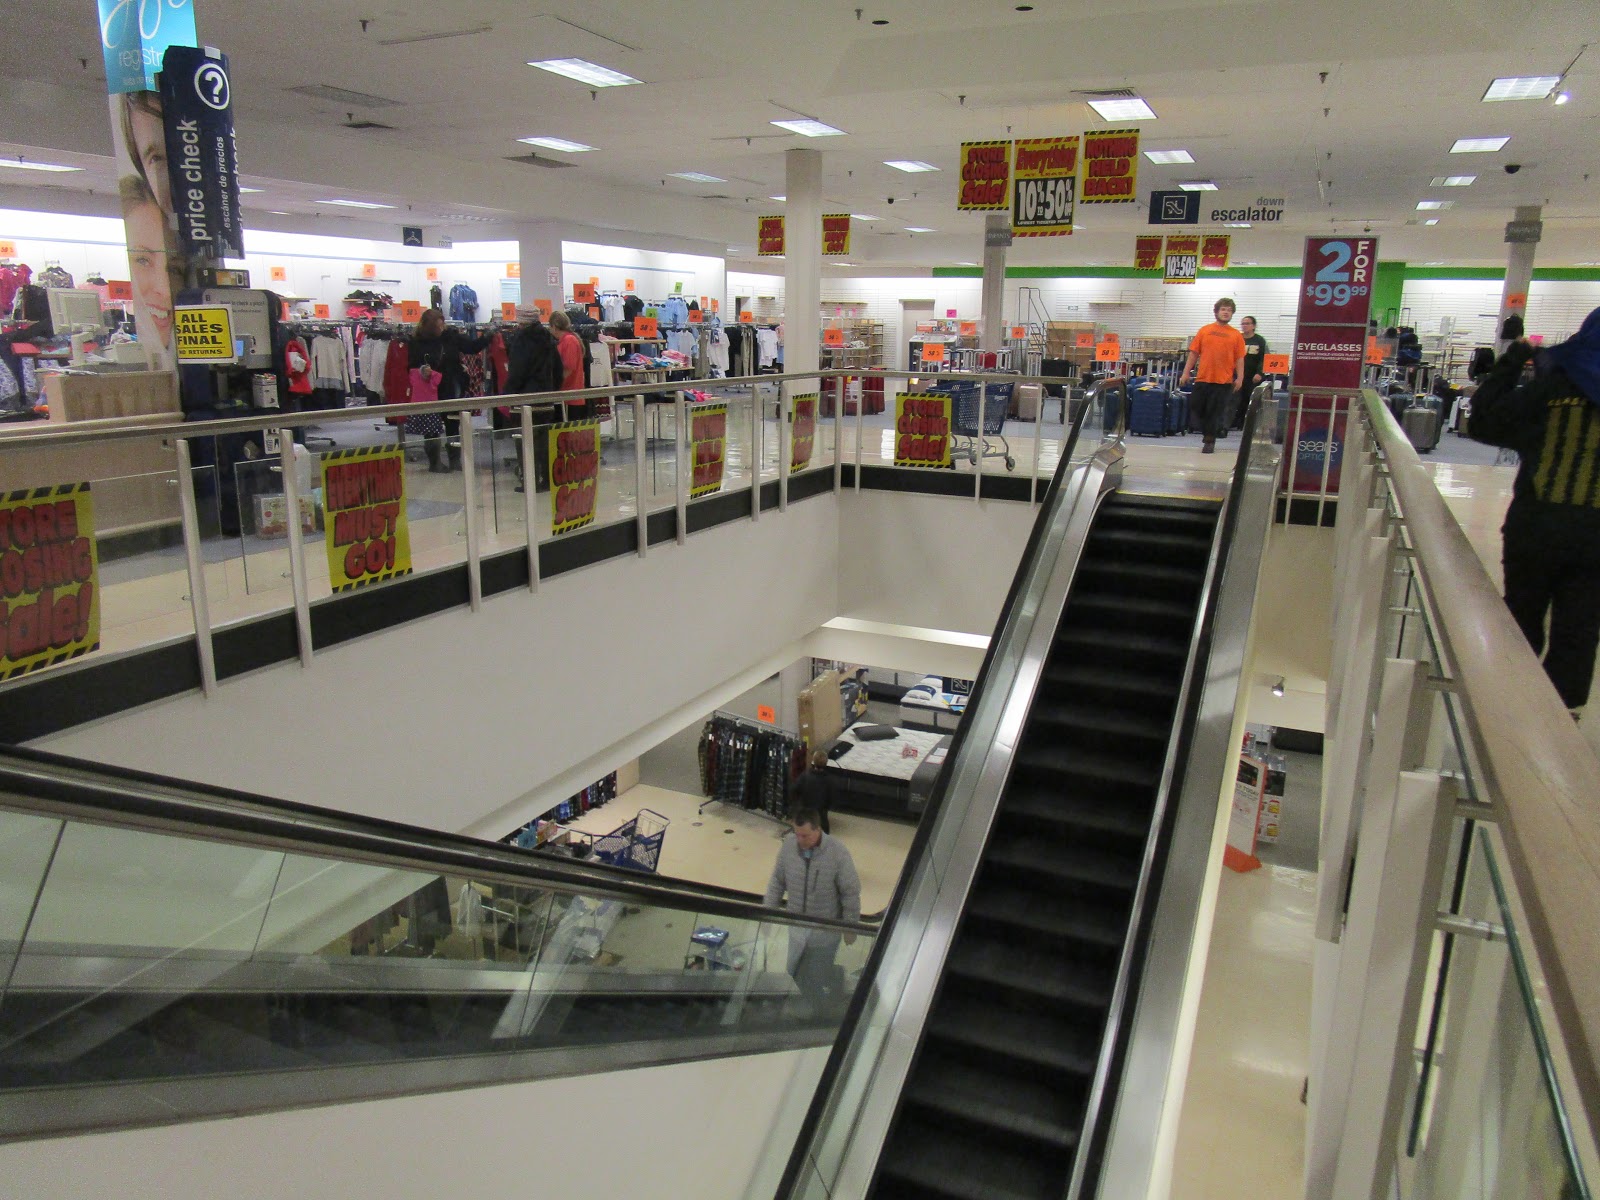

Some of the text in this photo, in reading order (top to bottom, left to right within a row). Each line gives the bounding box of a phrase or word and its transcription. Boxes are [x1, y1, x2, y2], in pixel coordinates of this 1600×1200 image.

[215, 136, 228, 173] precios
[1089, 158, 1131, 177] HELD
[176, 119, 213, 241] price check
[218, 174, 228, 188] de
[1256, 196, 1285, 207] down
[1210, 206, 1284, 222] escalator
[1315, 241, 1352, 282] 2
[1353, 240, 1370, 283] FOR
[181, 312, 208, 324] ALL
[175, 323, 224, 335] SALES
[177, 335, 223, 346] FINAL
[1297, 342, 1362, 352] EYEGLASSES
[333, 501, 400, 548] MUST
[343, 535, 397, 580] GO!
